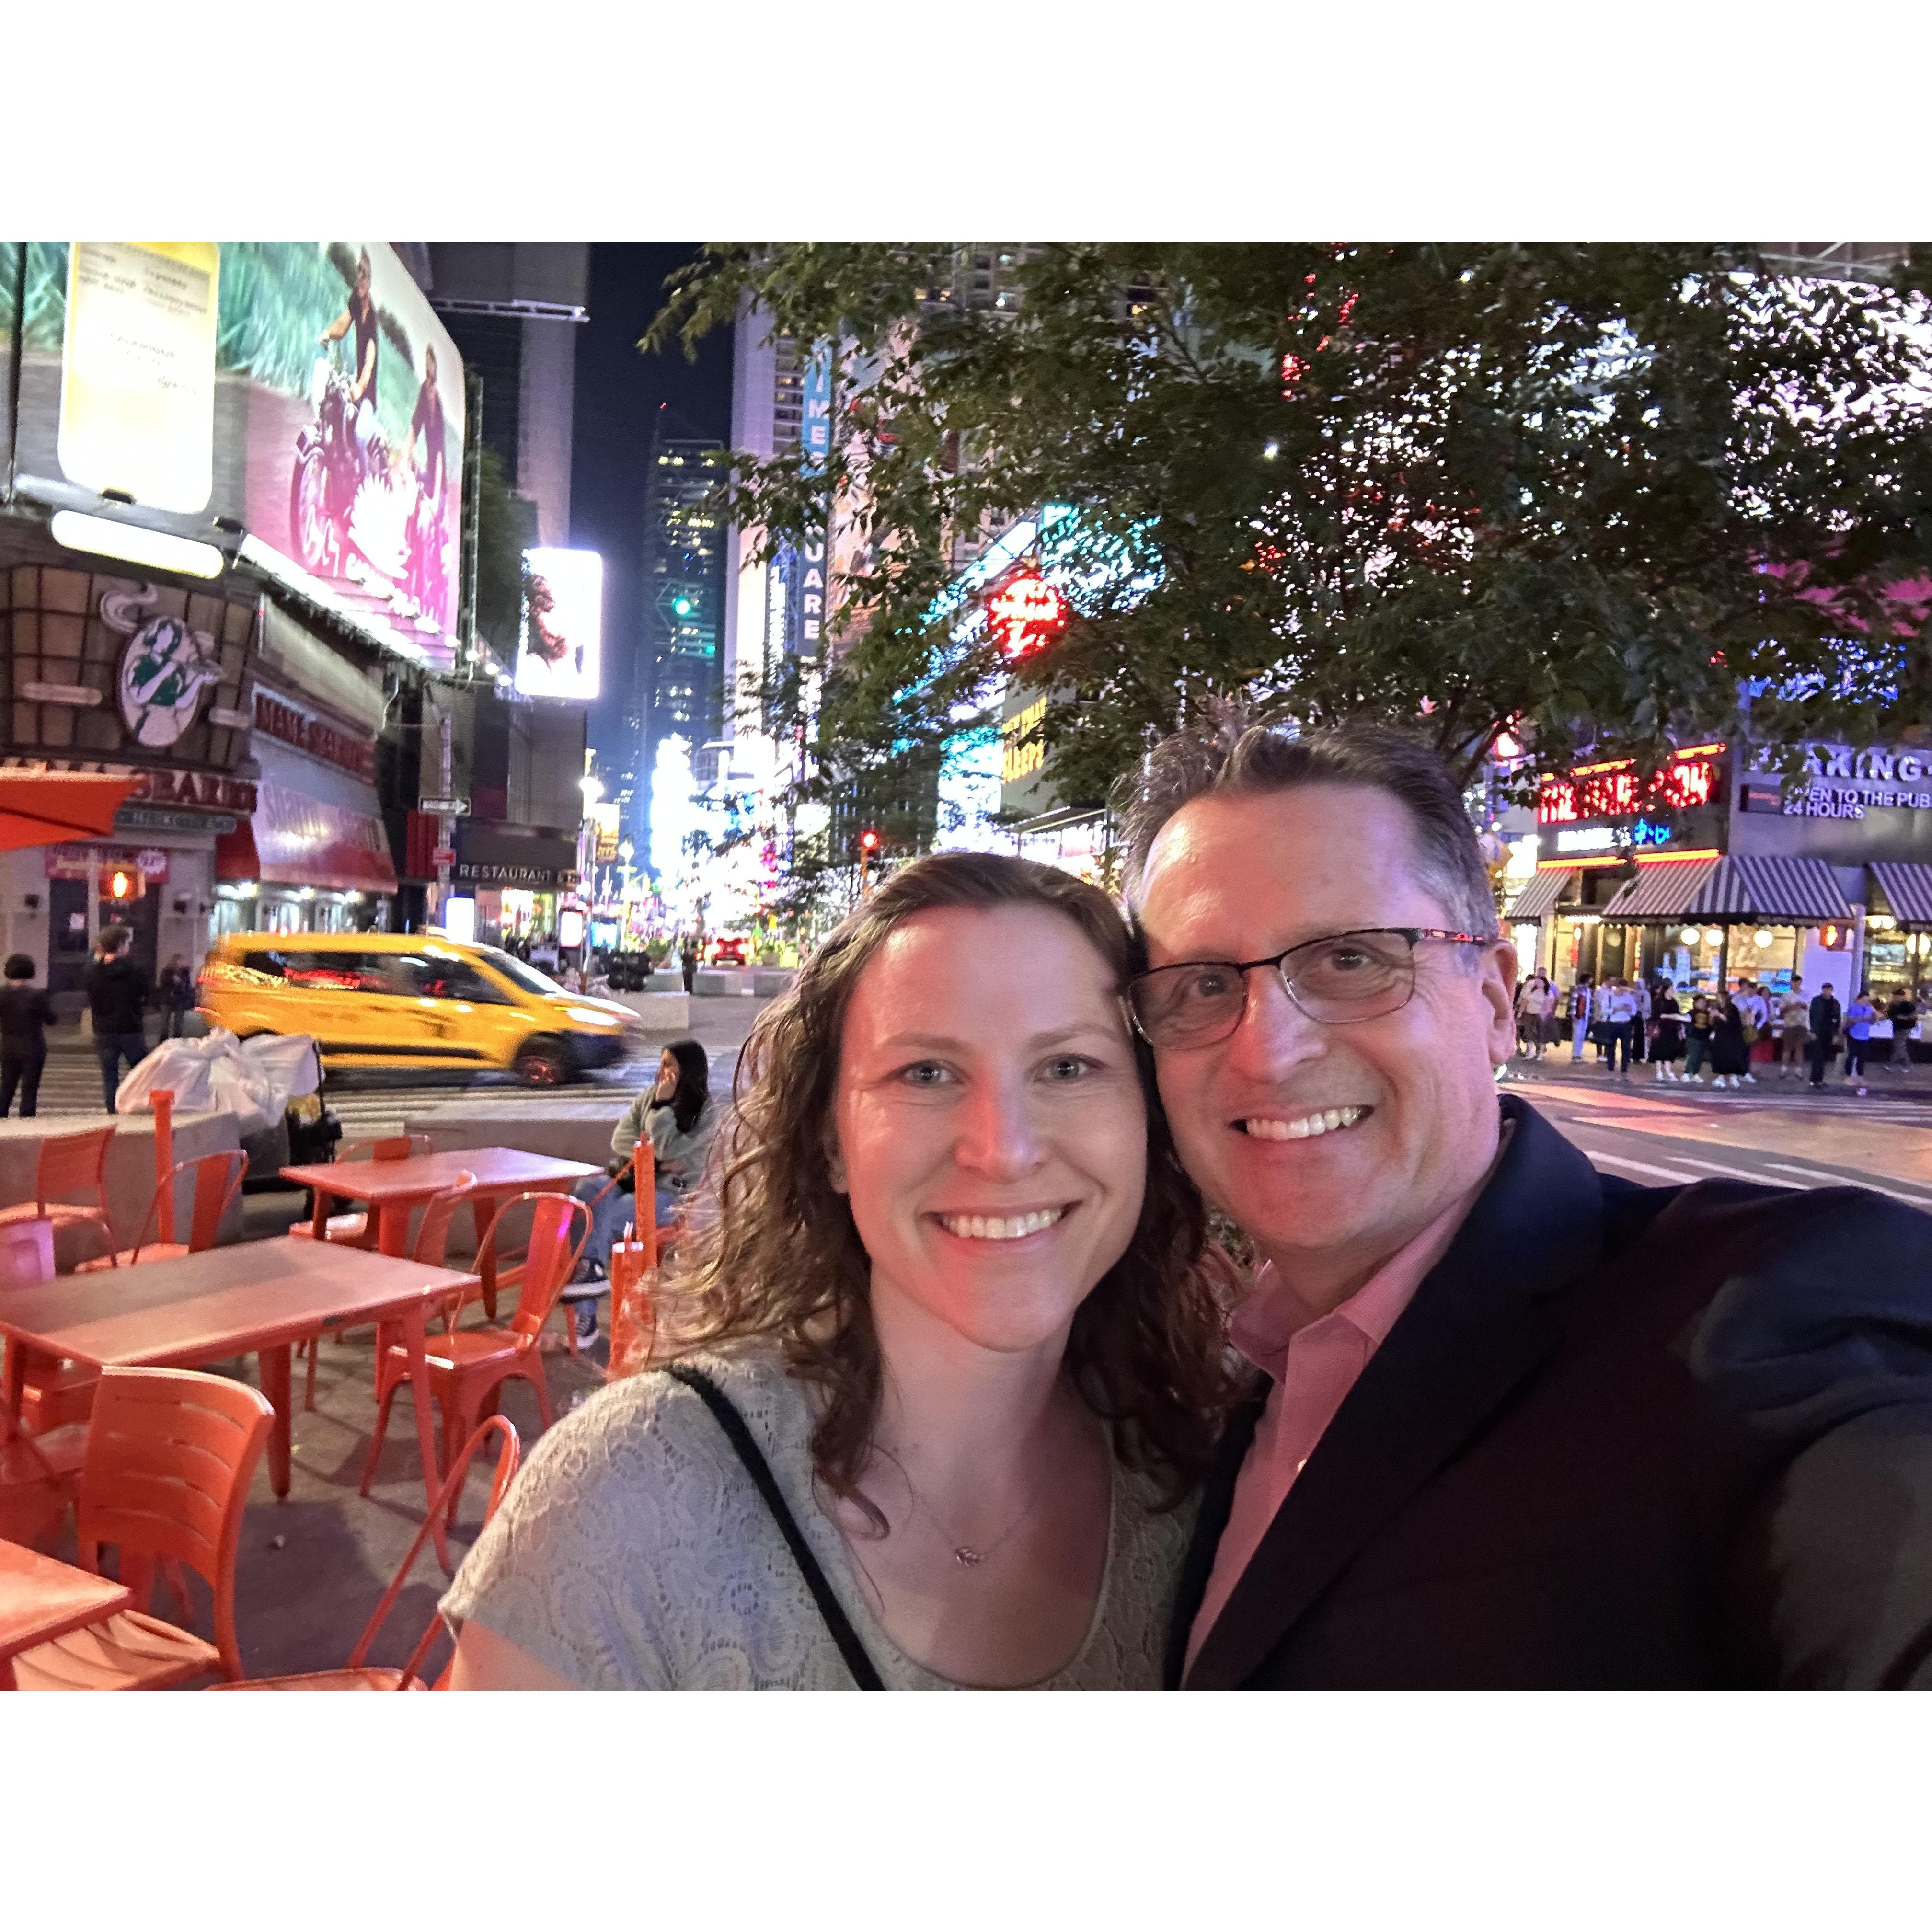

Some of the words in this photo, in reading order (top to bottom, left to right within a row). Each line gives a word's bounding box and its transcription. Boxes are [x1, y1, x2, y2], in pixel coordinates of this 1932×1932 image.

[1837, 789, 1858, 804] TO
[1863, 790, 1893, 806] THE
[1897, 792, 1932, 808] PUB
[1784, 800, 1803, 815] 24
[1806, 802, 1864, 820] HOURS
[459, 864, 551, 882] RESTAURANT
